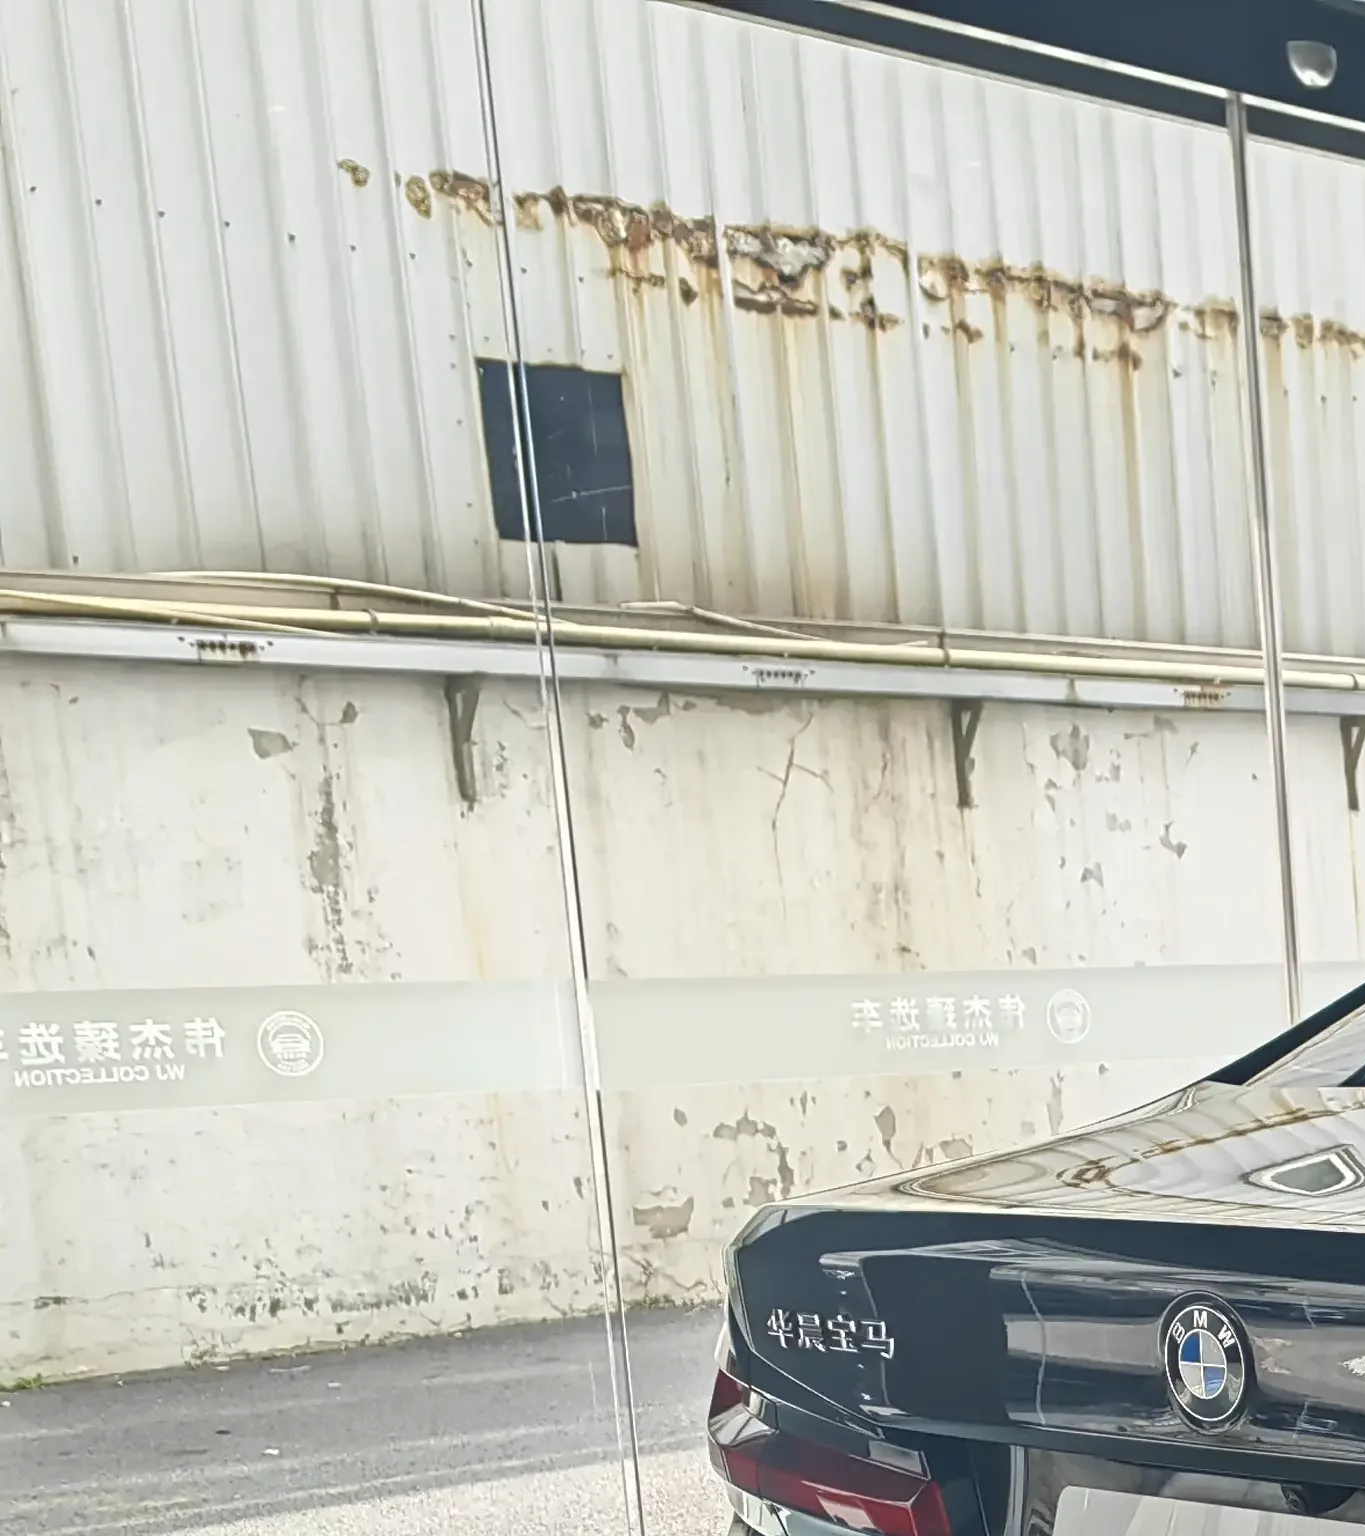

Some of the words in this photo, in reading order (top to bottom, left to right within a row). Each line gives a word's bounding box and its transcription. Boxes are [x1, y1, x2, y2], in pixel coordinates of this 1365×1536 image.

[766, 1308, 896, 1359] 华晨宝马
[1170, 1309, 1235, 1348] BMW
